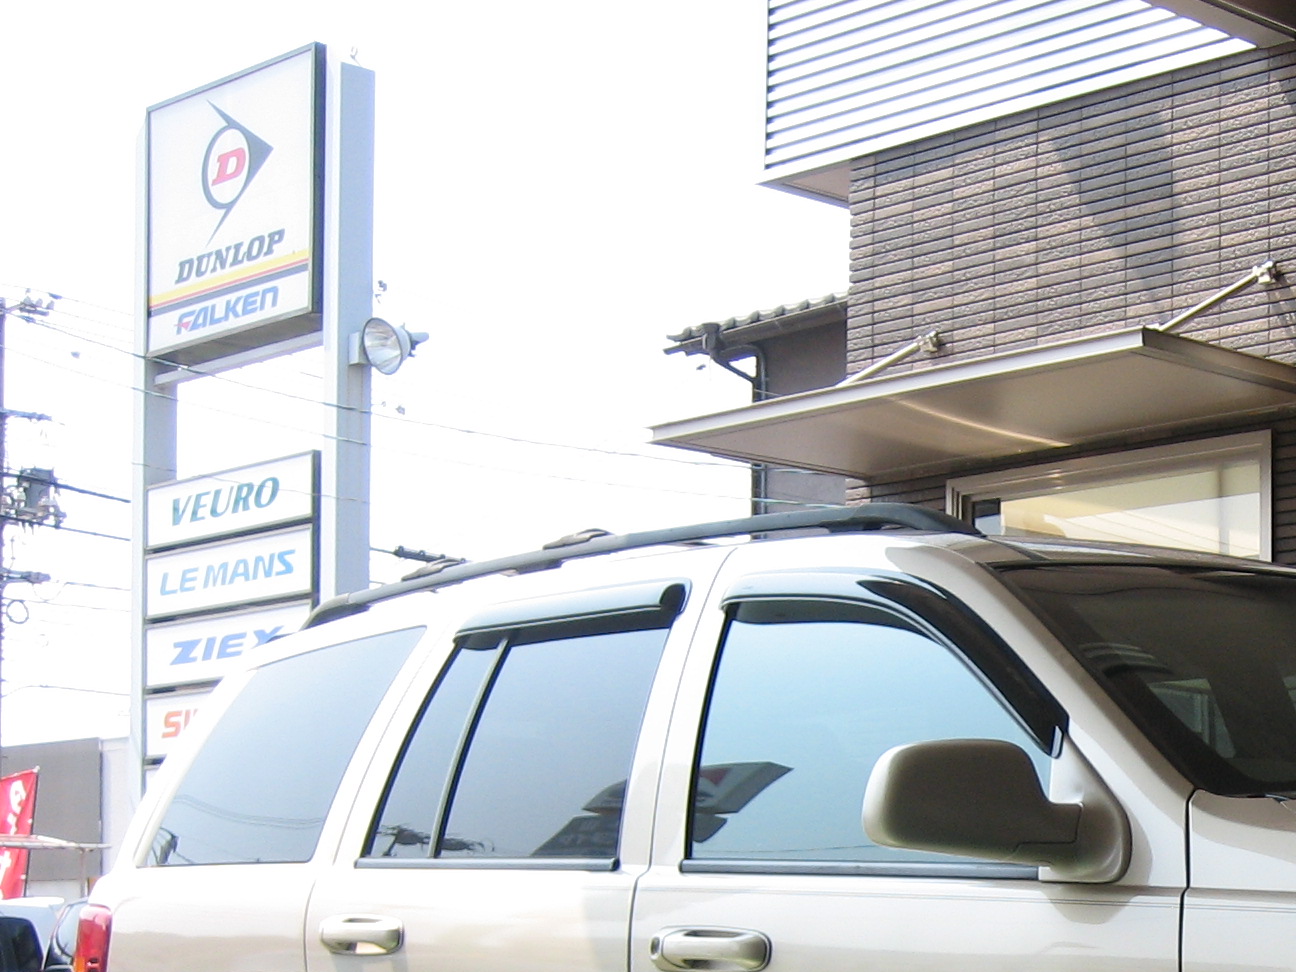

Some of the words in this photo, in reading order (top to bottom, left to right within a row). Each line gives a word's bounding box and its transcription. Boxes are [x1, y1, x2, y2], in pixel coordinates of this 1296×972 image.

[211, 147, 246, 187] D
[175, 228, 286, 285] DUNLOP
[174, 285, 279, 336] FALKEN
[172, 476, 280, 527] VEURO
[160, 567, 200, 596] LE
[203, 549, 296, 590] MANS
